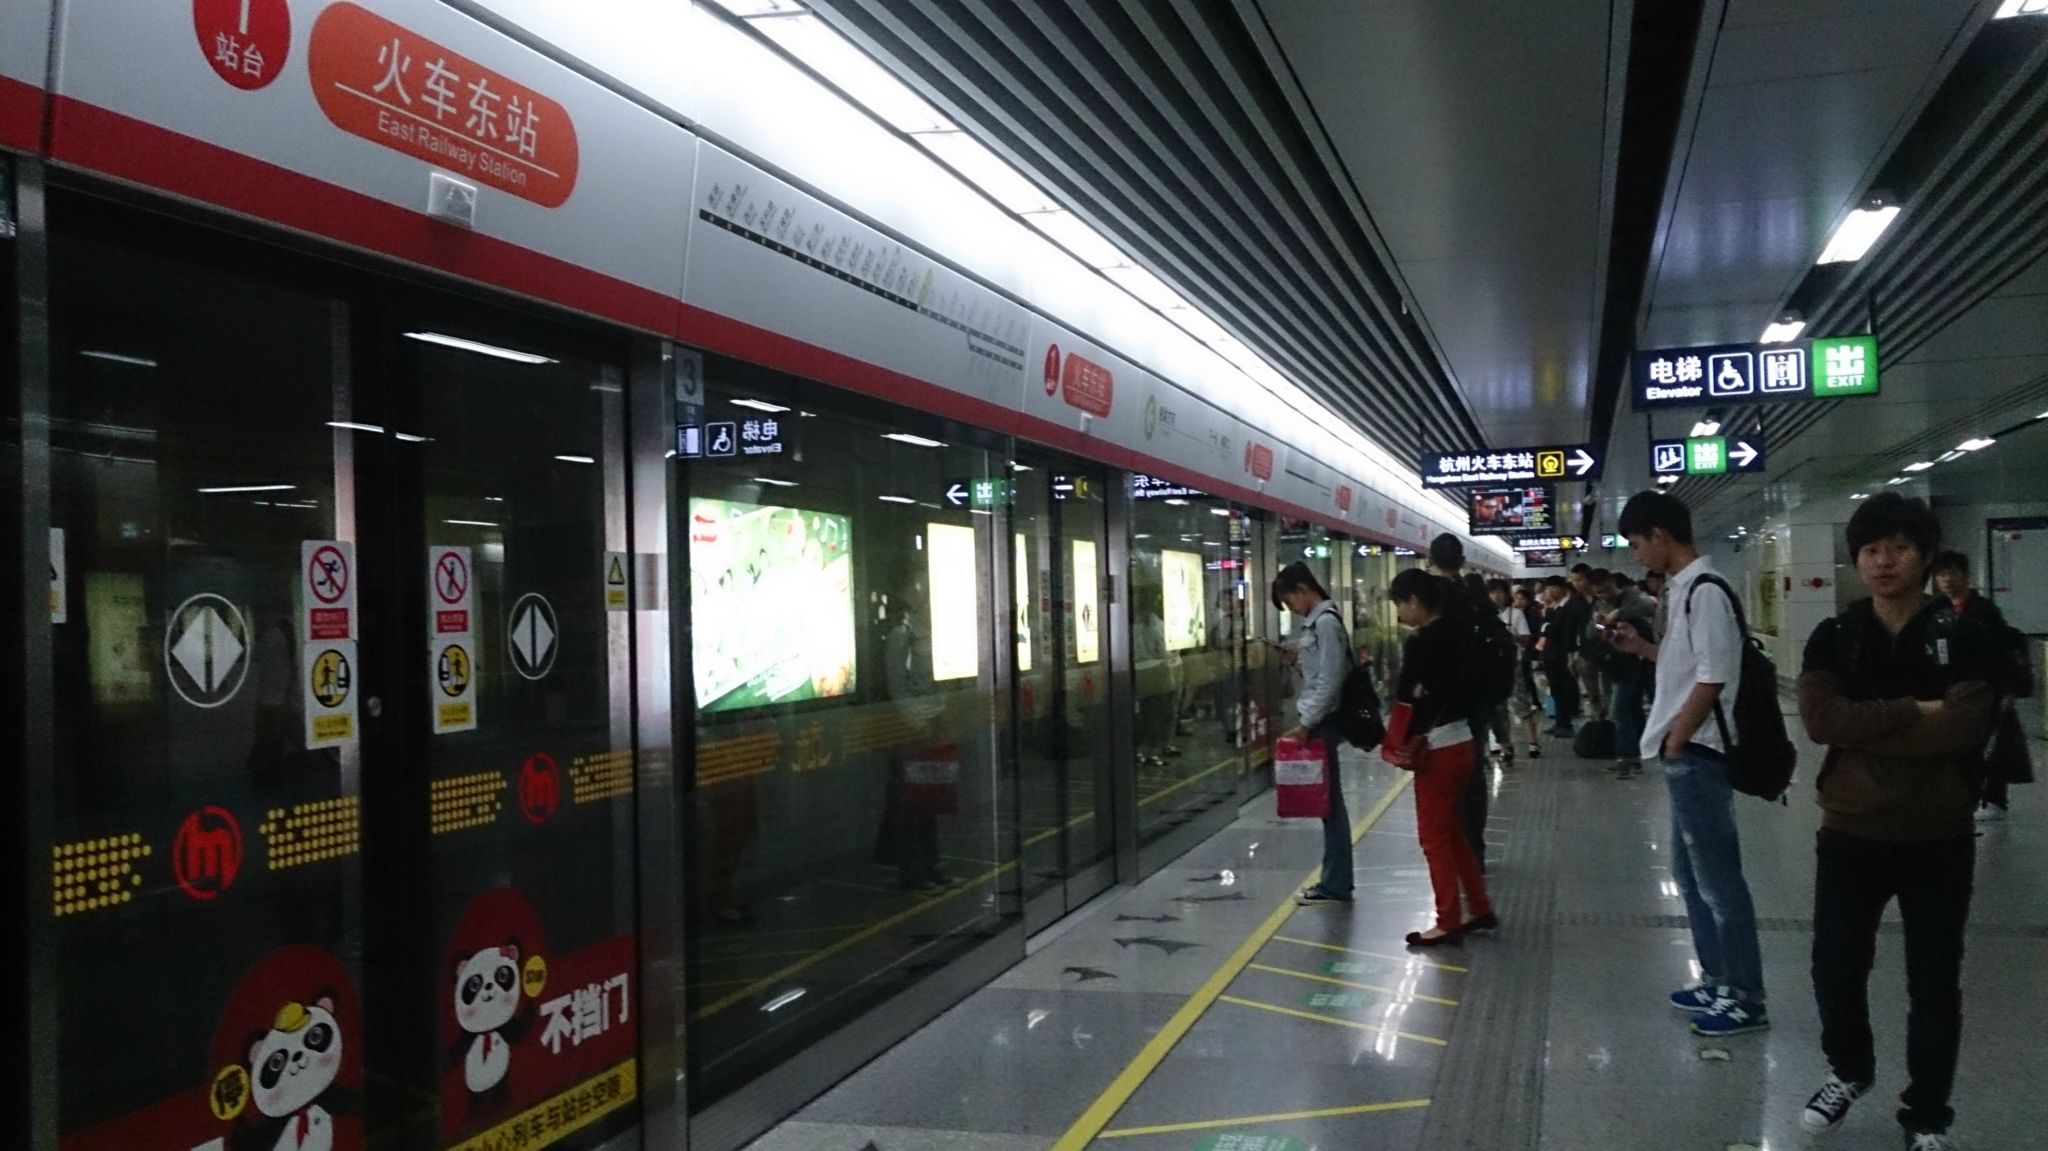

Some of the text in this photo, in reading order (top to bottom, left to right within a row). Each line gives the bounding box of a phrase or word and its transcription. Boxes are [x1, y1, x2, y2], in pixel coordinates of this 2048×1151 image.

[214, 31, 265, 79] 站台
[372, 38, 540, 158] 火车东站
[377, 110, 527, 186] East Railway Station
[1650, 355, 1703, 384] 电梯
[1827, 375, 1865, 388] EXIT
[1646, 385, 1703, 400] Elevator
[1439, 452, 1534, 473] 杭州火车东站
[539, 972, 629, 1055] 不挡门
